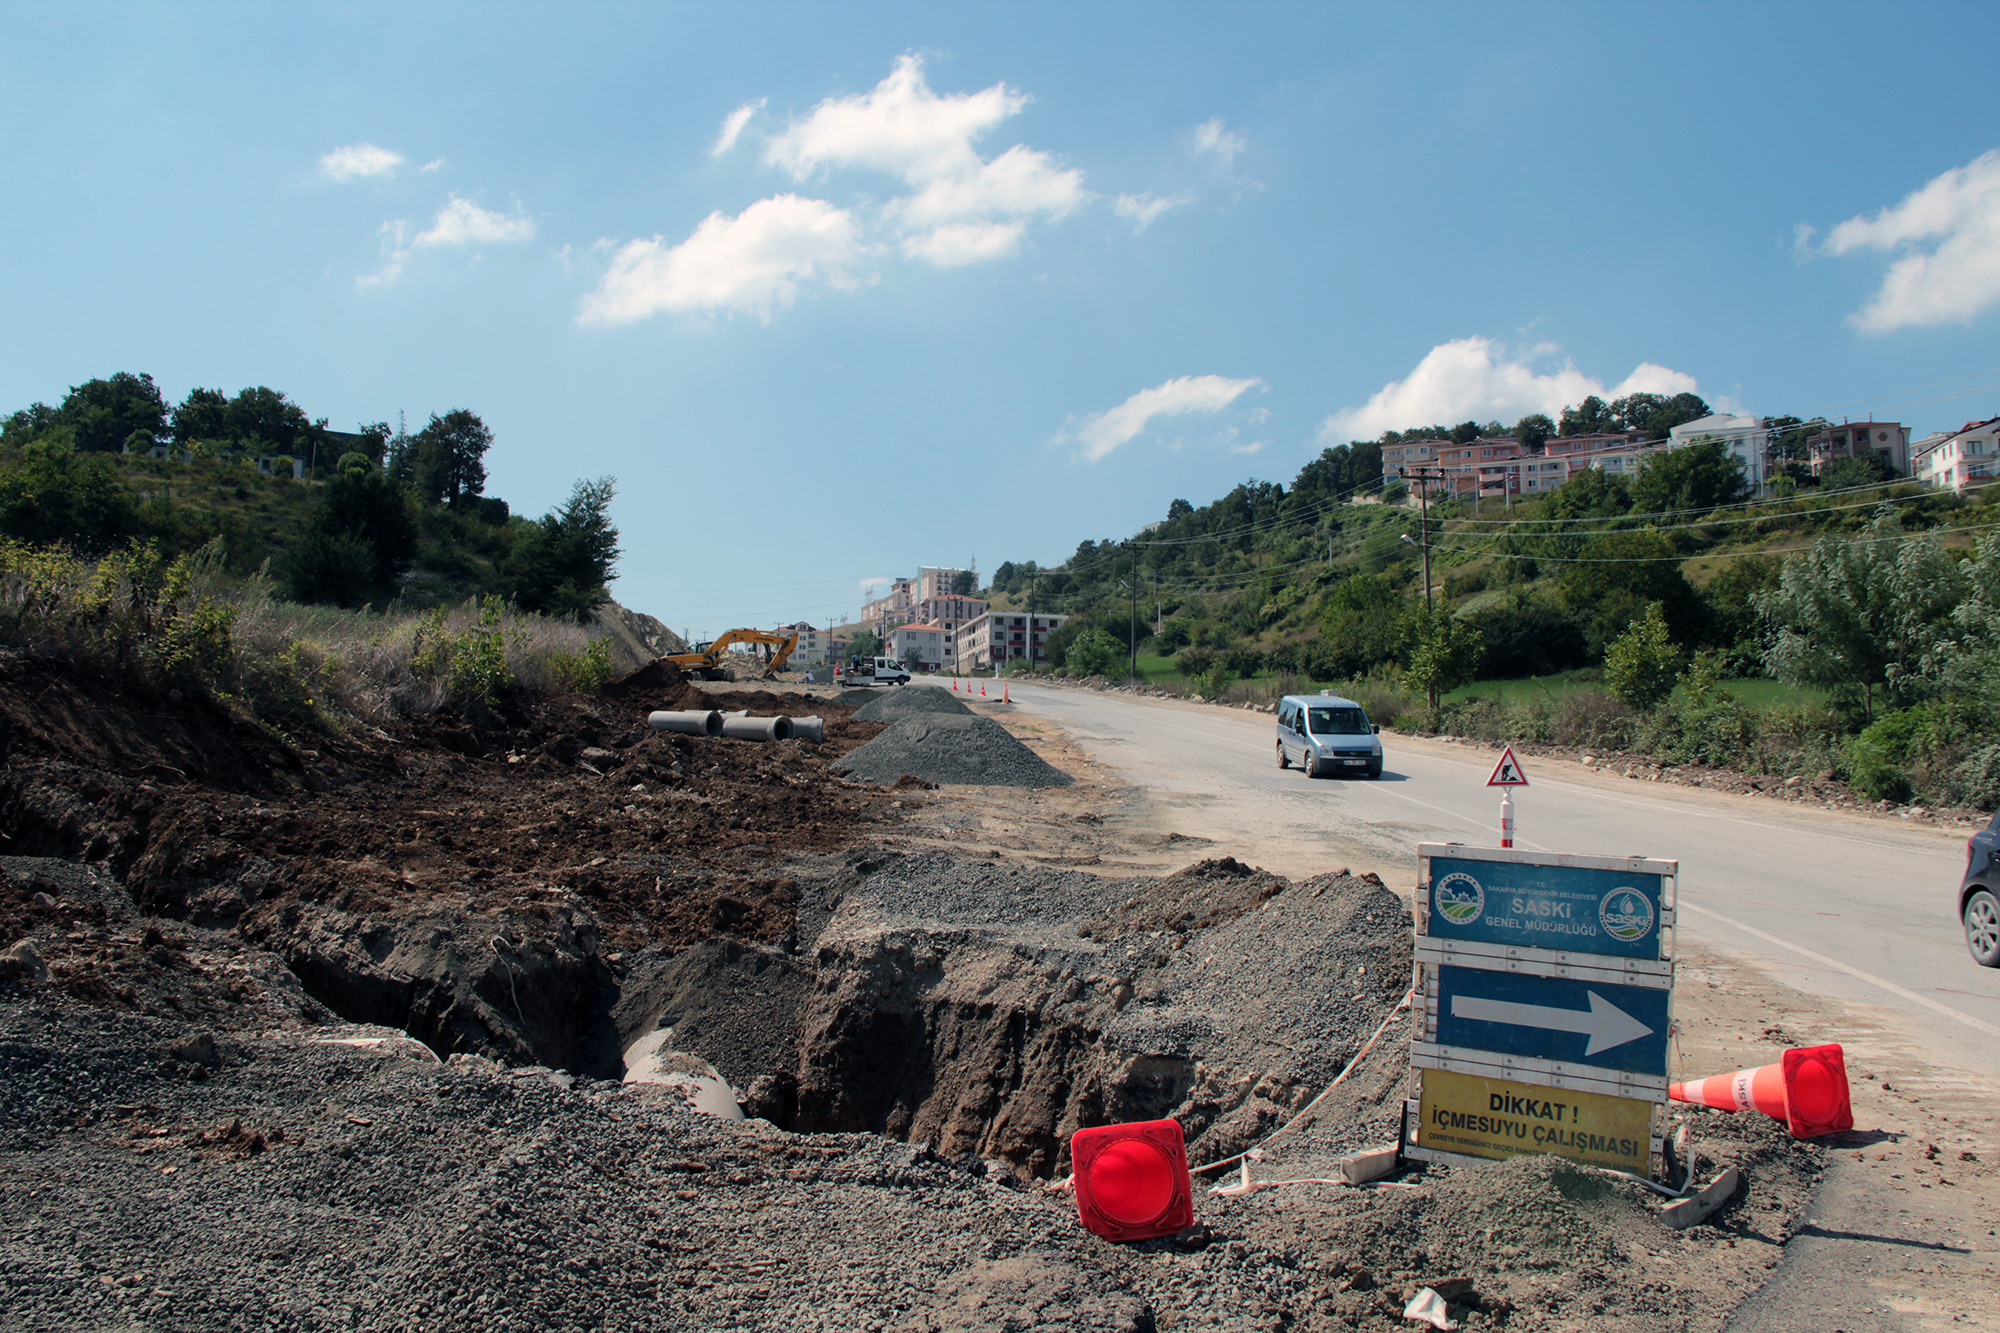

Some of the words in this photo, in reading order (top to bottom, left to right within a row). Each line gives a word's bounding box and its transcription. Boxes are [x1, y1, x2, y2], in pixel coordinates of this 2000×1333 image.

[1487, 885, 1517, 893] SAKARYA
[1518, 887, 1558, 897] BÜYÜKŞEHİR
[1560, 891, 1597, 901] BELEDİYESİ
[1485, 916, 1522, 929] GENEL
[1525, 920, 1597, 936] MÜDÜRLÜĞÜ
[1489, 1090, 1567, 1122] DİKKAT
[1572, 1106, 1579, 1124] !
[1432, 1105, 1527, 1139] İÇMESUYU
[1532, 1125, 1639, 1157] ÇALIŞMASI
[1428, 1132, 1455, 1143] ÇEVREYE
[1456, 1137, 1492, 1149] VERDİĞİMİZ
[1492, 1143, 1514, 1153] GEÇİCİ
